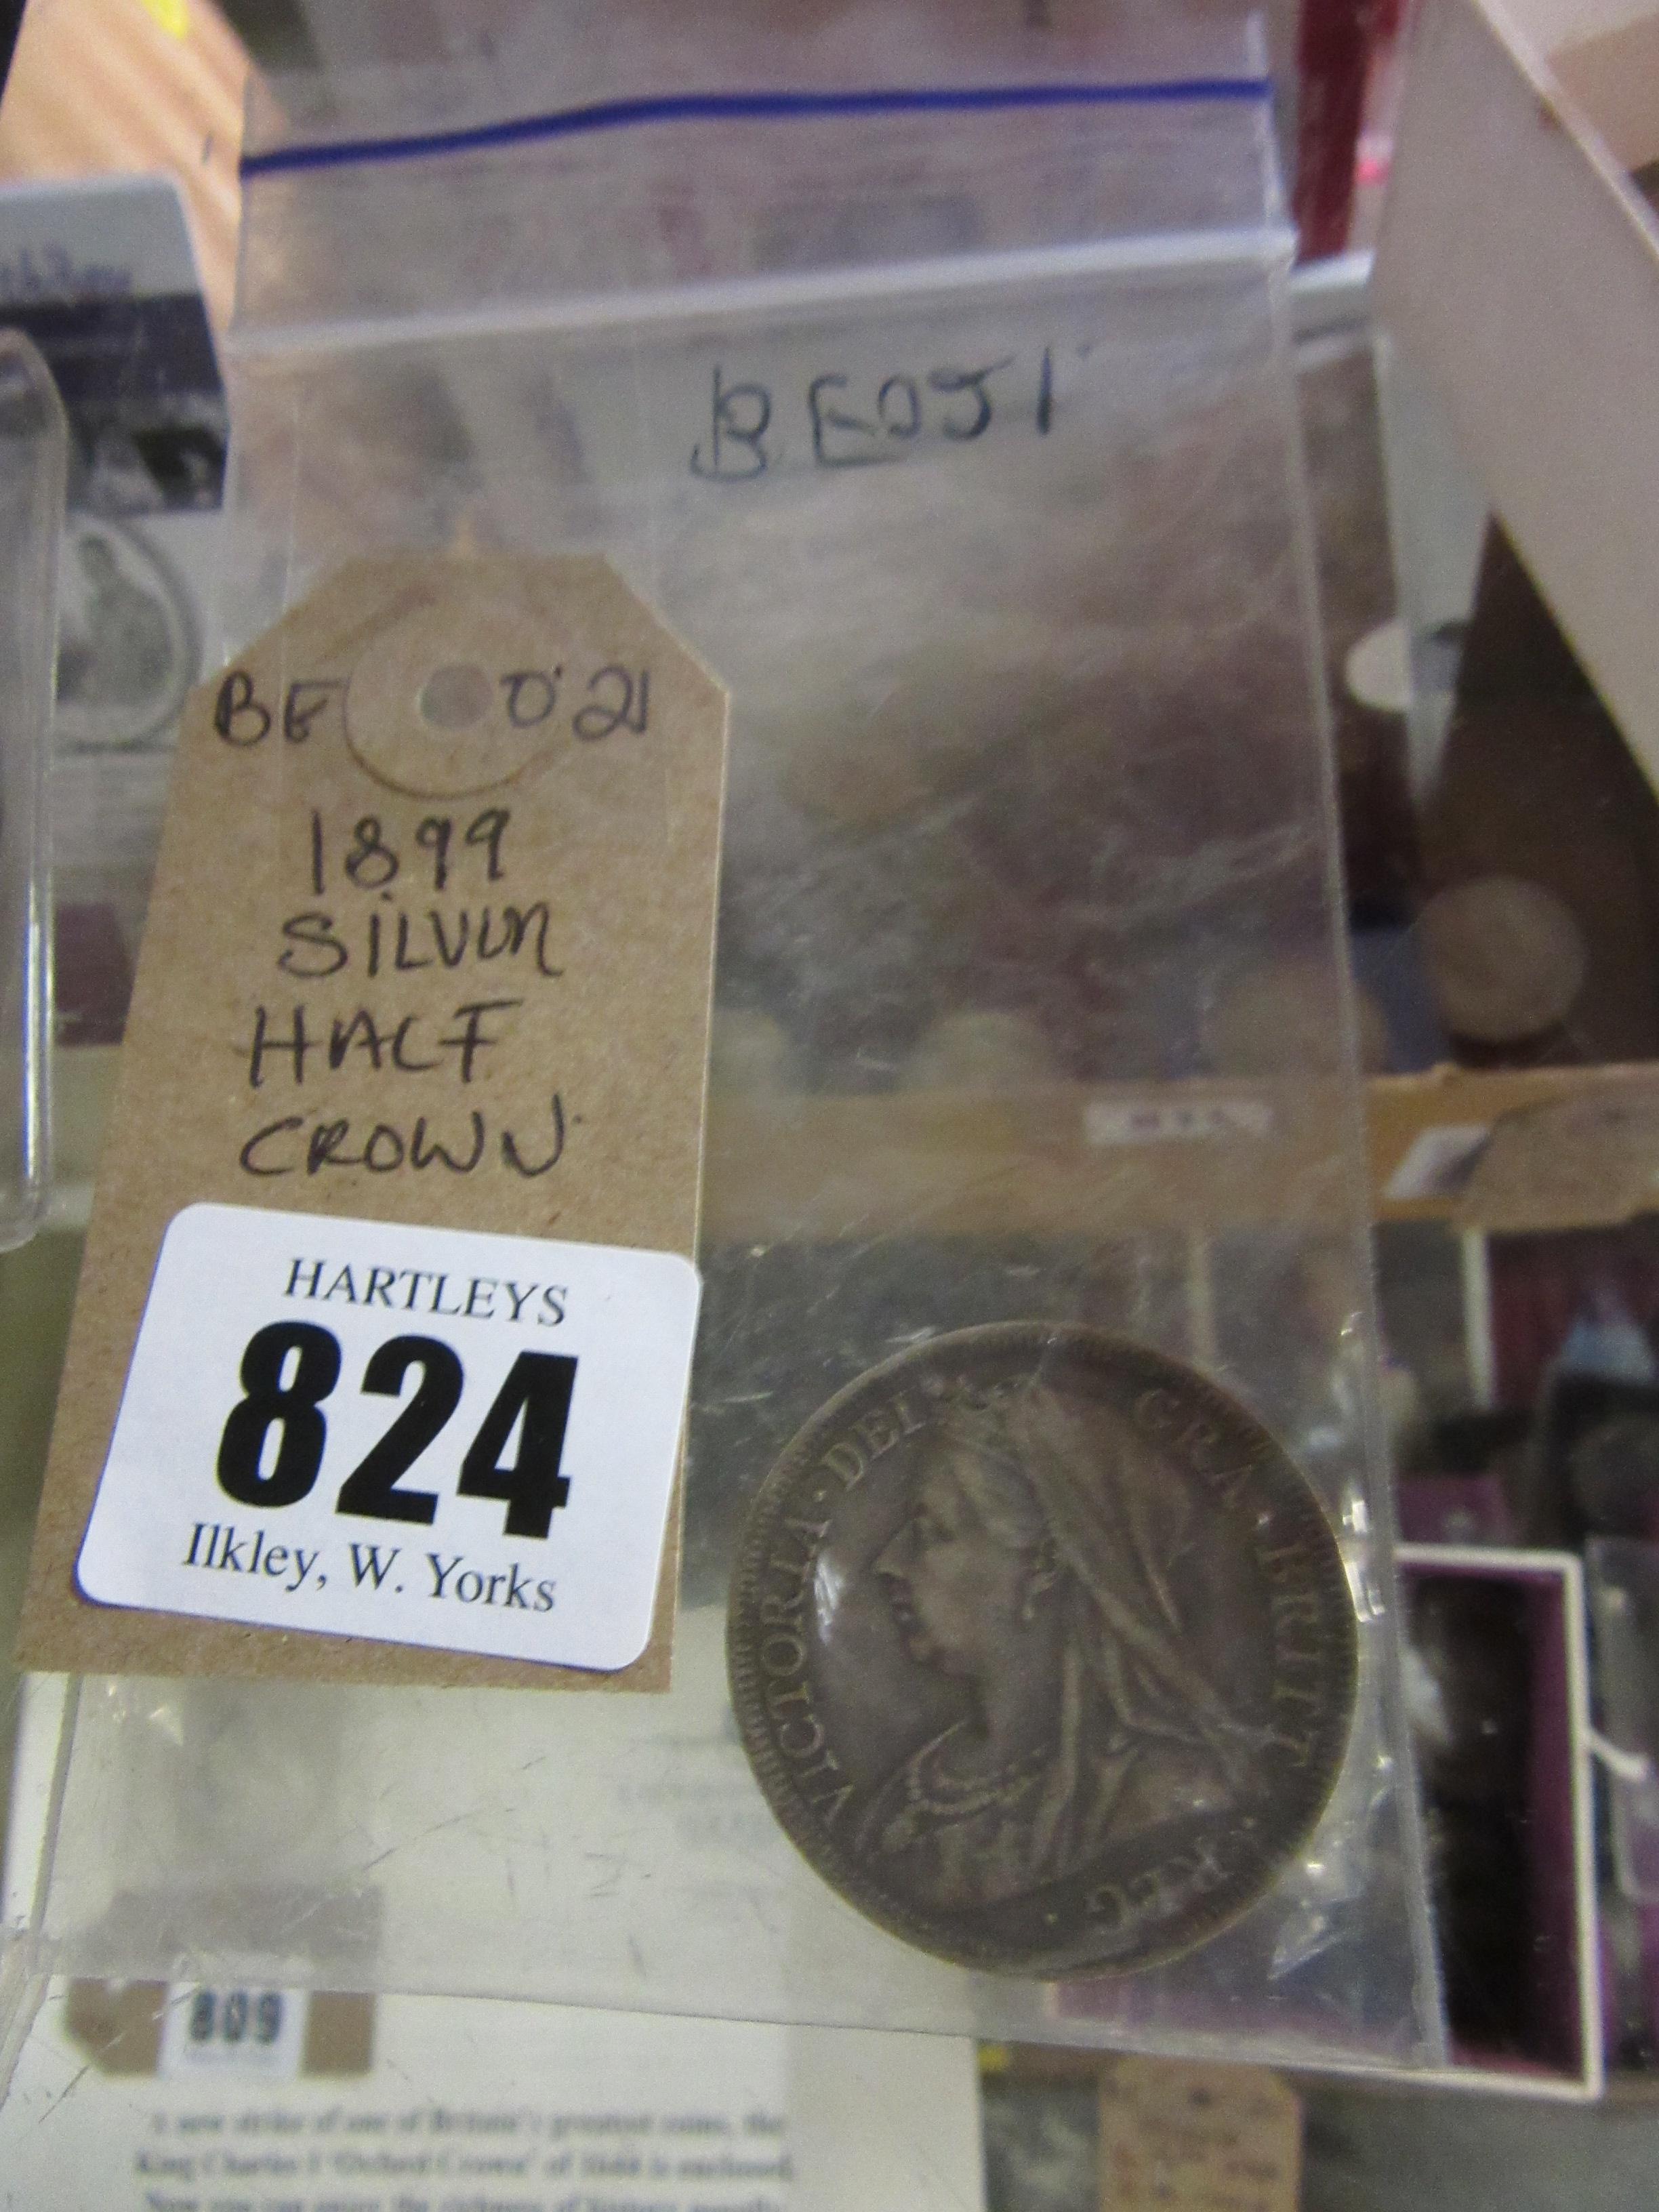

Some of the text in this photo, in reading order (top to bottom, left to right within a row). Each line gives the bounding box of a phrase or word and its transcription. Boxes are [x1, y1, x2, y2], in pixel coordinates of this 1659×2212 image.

[310, 809, 512, 895] 1899
[239, 1092, 565, 1179] CROWN
[281, 1258, 569, 1327] HARTLEYS
[216, 1320, 579, 1539] 824
[182, 1523, 556, 1613] Ilkley, W. Yorks
